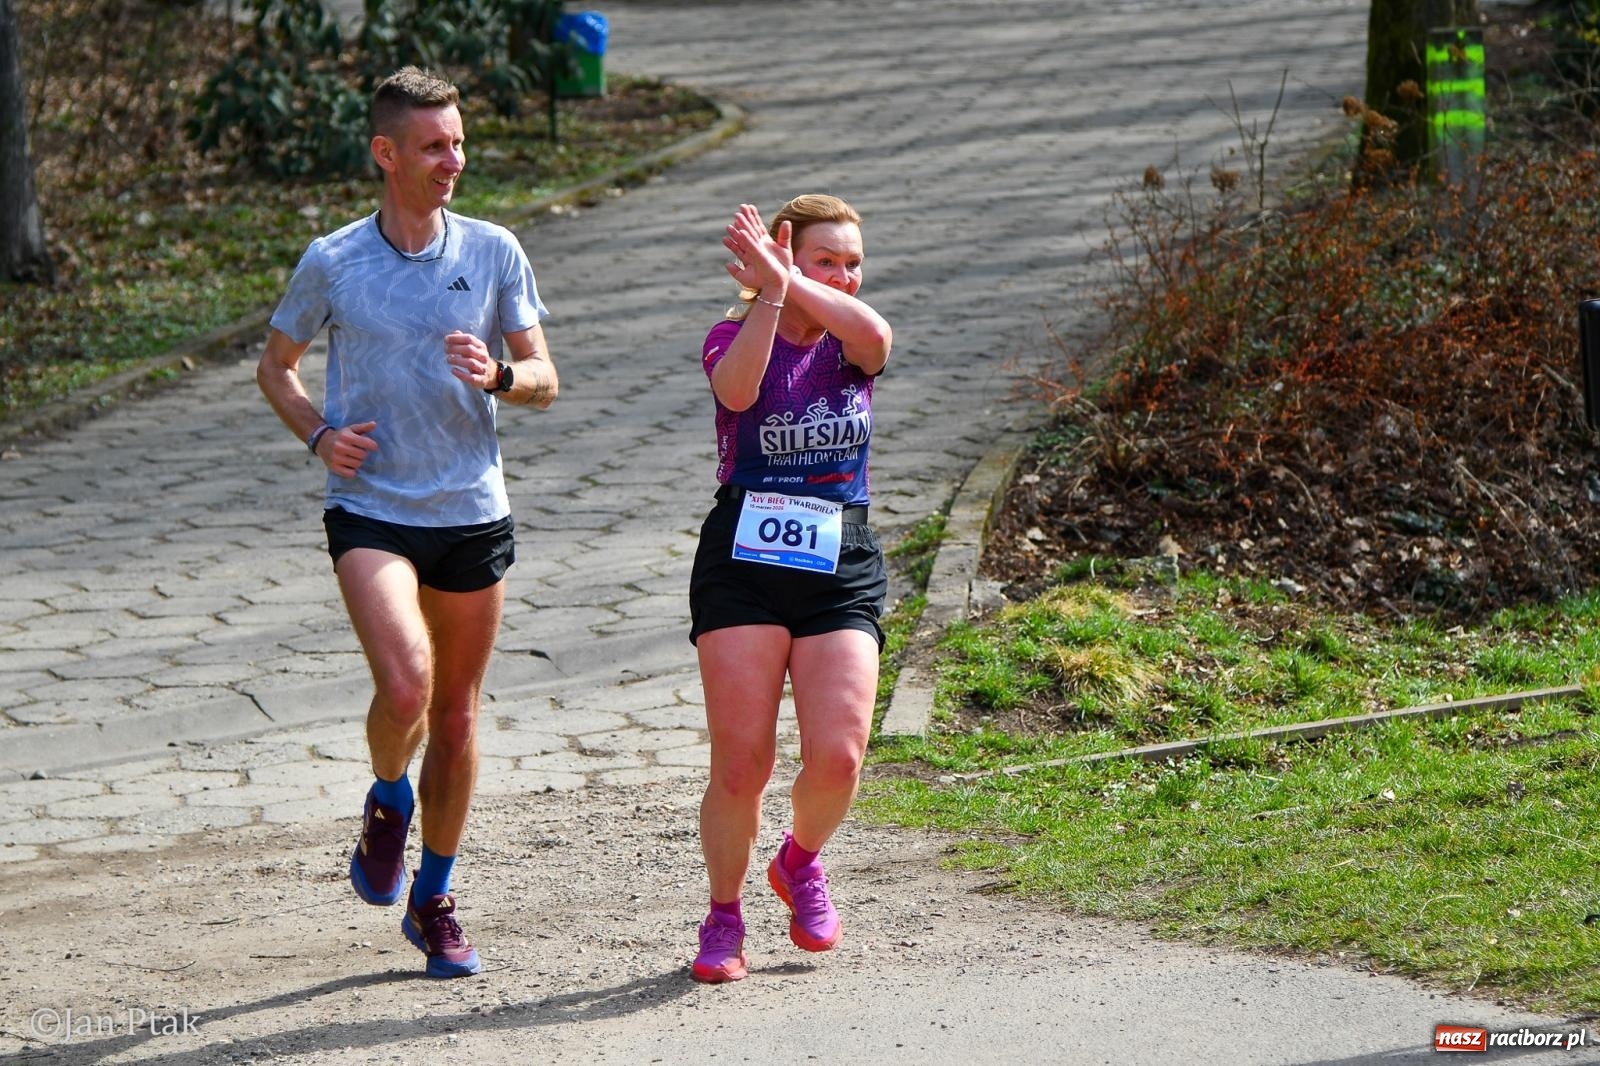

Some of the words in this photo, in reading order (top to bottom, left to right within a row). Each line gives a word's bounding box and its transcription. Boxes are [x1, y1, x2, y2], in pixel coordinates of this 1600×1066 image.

[762, 414, 869, 453] SILESIAN
[767, 450, 832, 467] TRIATHLON
[833, 446, 859, 462] TEAM
[751, 495, 766, 504] XIV
[767, 496, 785, 505] BIEG
[788, 498, 834, 515] TWARDZIELA
[758, 517, 818, 550] 081
